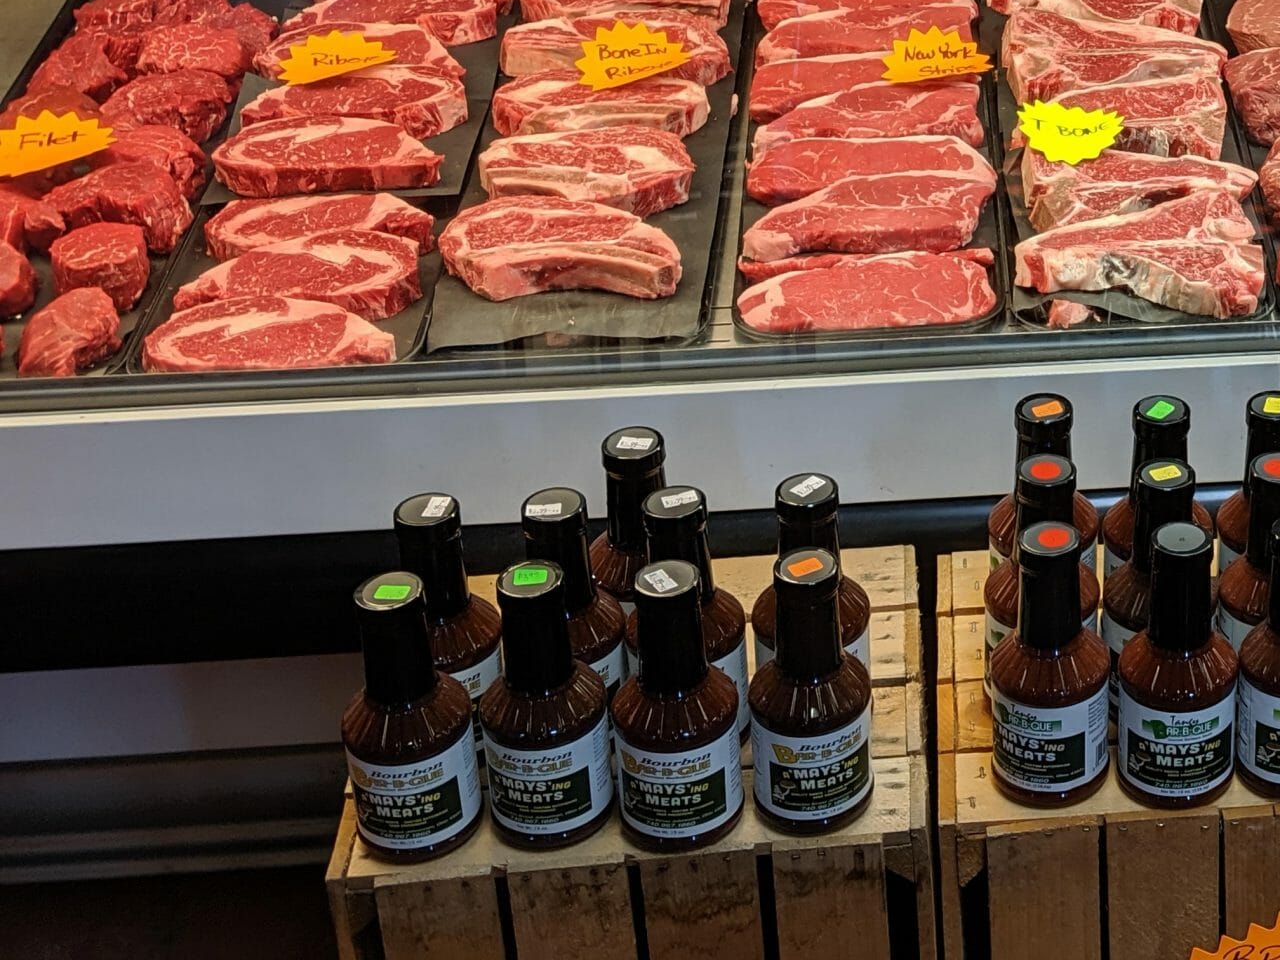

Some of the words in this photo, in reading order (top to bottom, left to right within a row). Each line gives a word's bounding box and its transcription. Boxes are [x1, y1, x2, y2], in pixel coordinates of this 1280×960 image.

[596, 44, 640, 60] Bone
[904, 46, 935, 62] New
[939, 42, 976, 59] York
[1009, 704, 1038, 721] Tangy
[1169, 714, 1199, 726] Tangy
[798, 724, 862, 753] Bourbon
[501, 751, 573, 765] Bourbon
[640, 752, 711, 767] Bourbon
[1002, 741, 1057, 762] MEATS
[1156, 751, 1215, 767] MEATS
[371, 761, 443, 781] Bourbon
[800, 768, 855, 791] MEATS
[508, 791, 564, 802] MEATS
[644, 793, 702, 807] MEATS
[376, 798, 434, 818] MEATS
